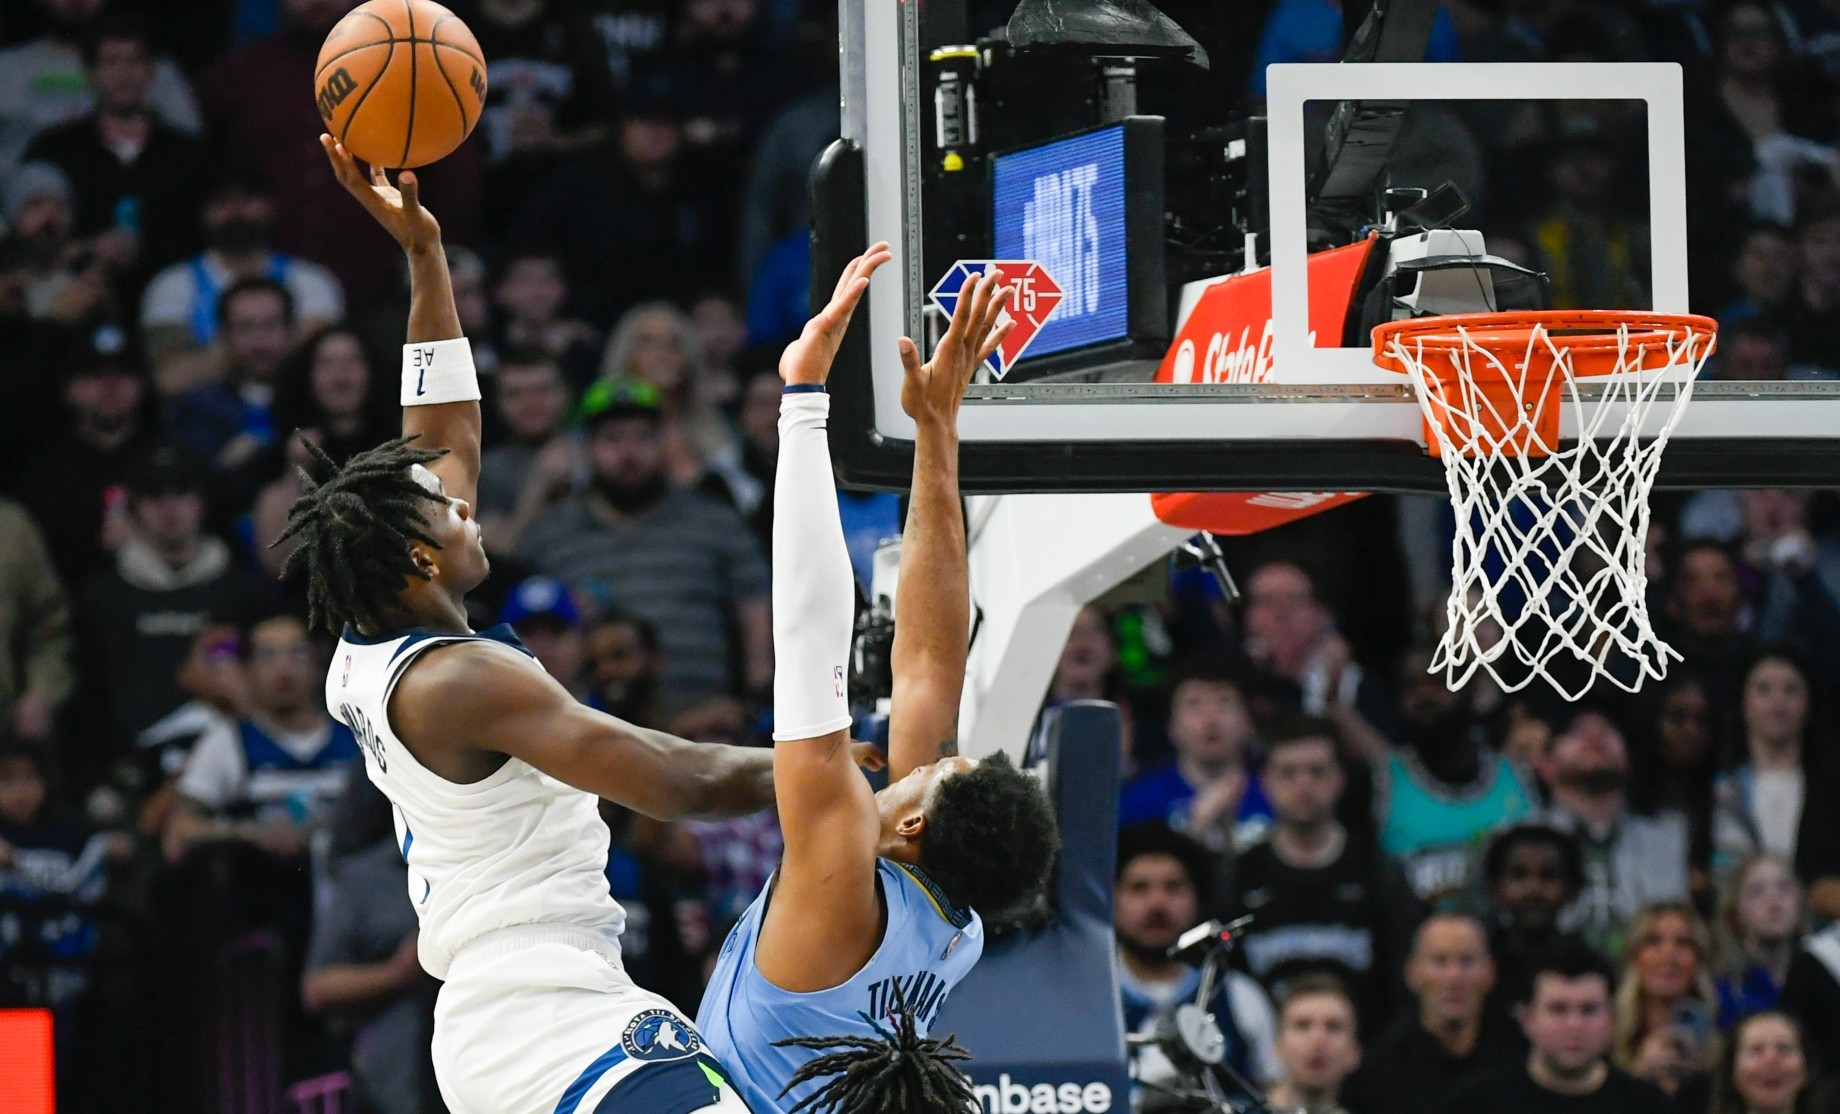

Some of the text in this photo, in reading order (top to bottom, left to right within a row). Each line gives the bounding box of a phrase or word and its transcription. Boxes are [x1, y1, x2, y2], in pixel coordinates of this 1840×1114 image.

[1010, 278, 1036, 311] 75
[413, 348, 434, 366] AE
[416, 369, 425, 396] 1
